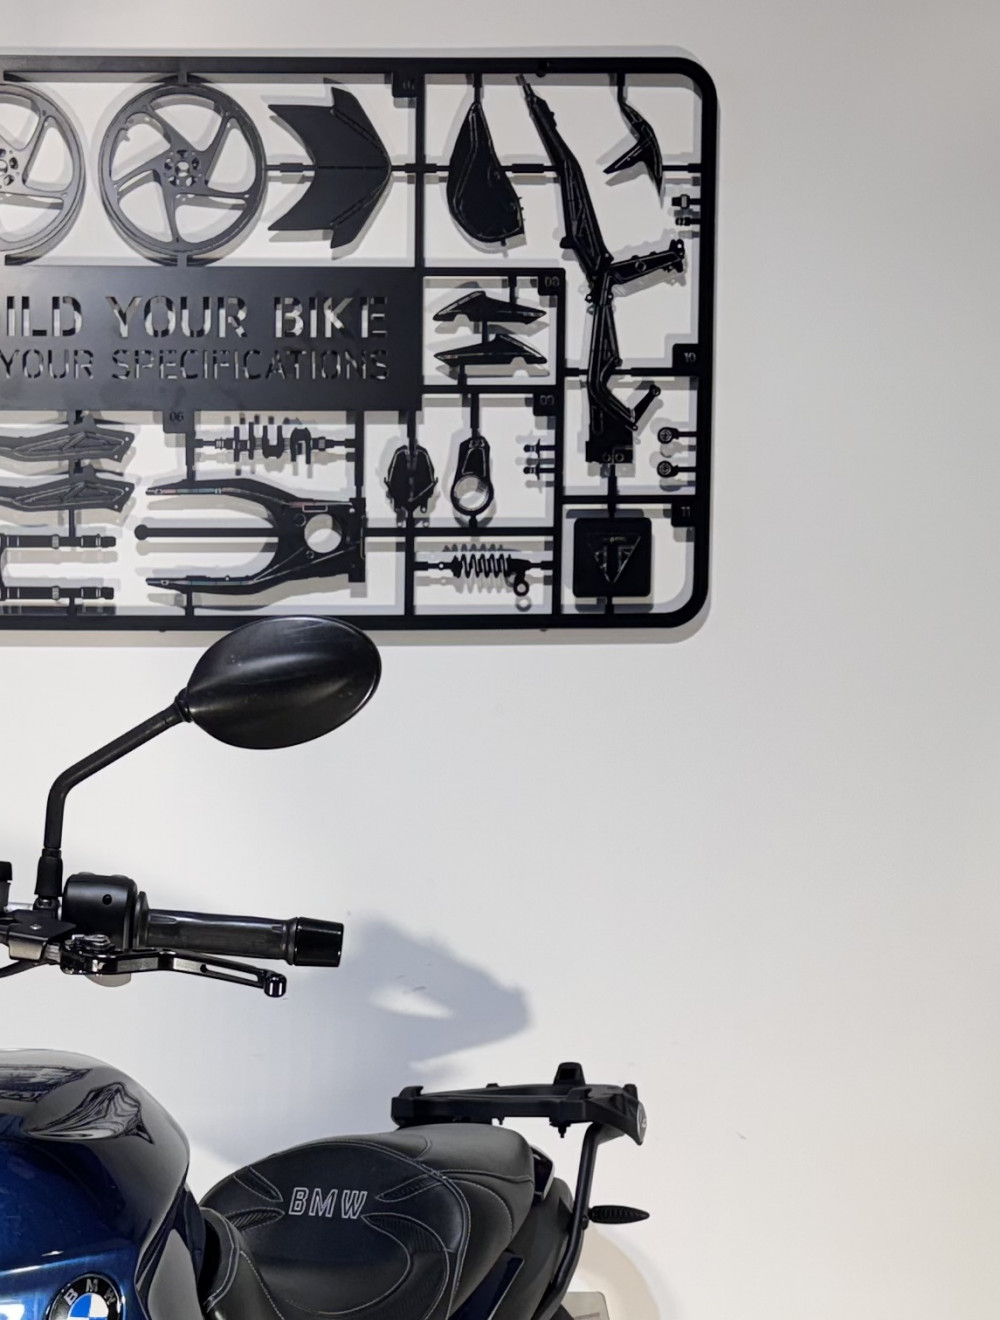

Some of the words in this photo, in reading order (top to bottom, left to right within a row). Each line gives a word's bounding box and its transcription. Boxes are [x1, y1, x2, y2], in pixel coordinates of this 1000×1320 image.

[105, 295, 248, 338] YOUR
[273, 295, 388, 338] BIKE
[111, 349, 389, 380] SPECIFICATIONS
[169, 411, 185, 422] 06
[287, 1186, 368, 1220] BMW
[63, 1278, 117, 1306] BMW
